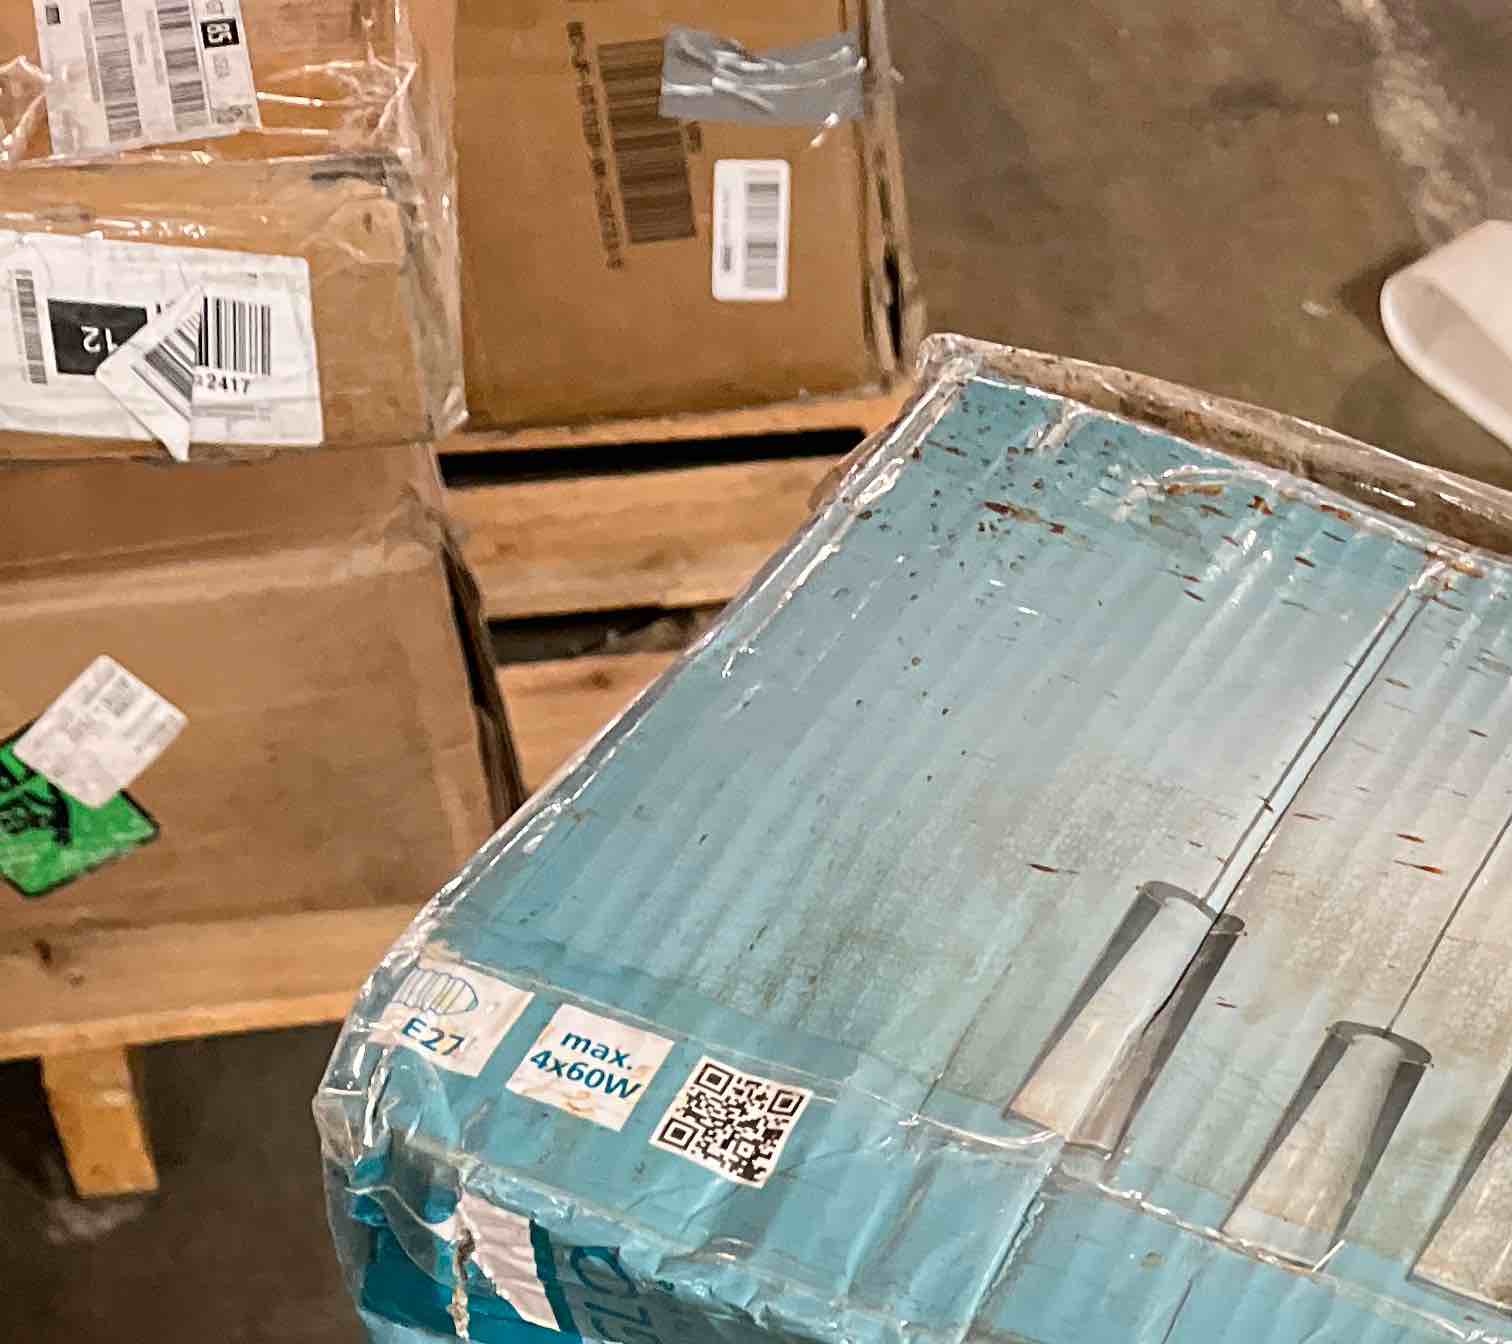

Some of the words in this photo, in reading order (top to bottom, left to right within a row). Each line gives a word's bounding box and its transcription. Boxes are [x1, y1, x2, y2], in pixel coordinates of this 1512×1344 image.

[401, 1016, 465, 1057] E27
[559, 1031, 633, 1071] max.
[529, 1050, 642, 1100] 4x60W
